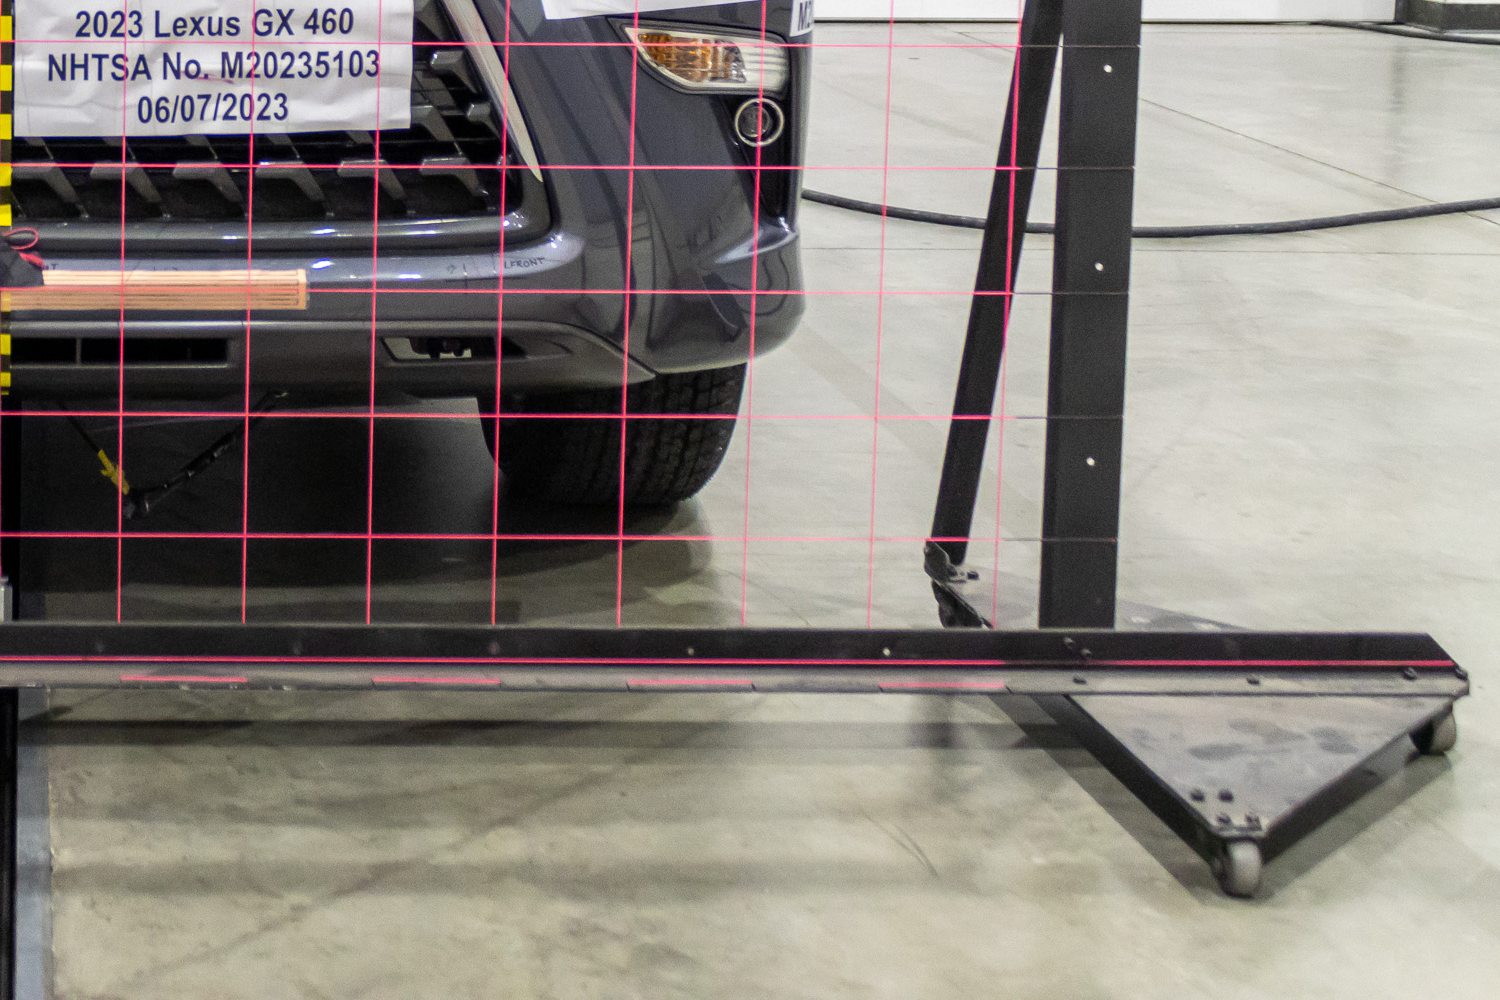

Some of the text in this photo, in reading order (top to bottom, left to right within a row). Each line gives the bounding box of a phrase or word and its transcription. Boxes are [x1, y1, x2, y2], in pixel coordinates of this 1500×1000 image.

[75, 7, 354, 39] 2023 Lexus GX 460
[48, 50, 380, 82] NHTSA No. M20235103
[137, 93, 289, 124] 06/07/2023
